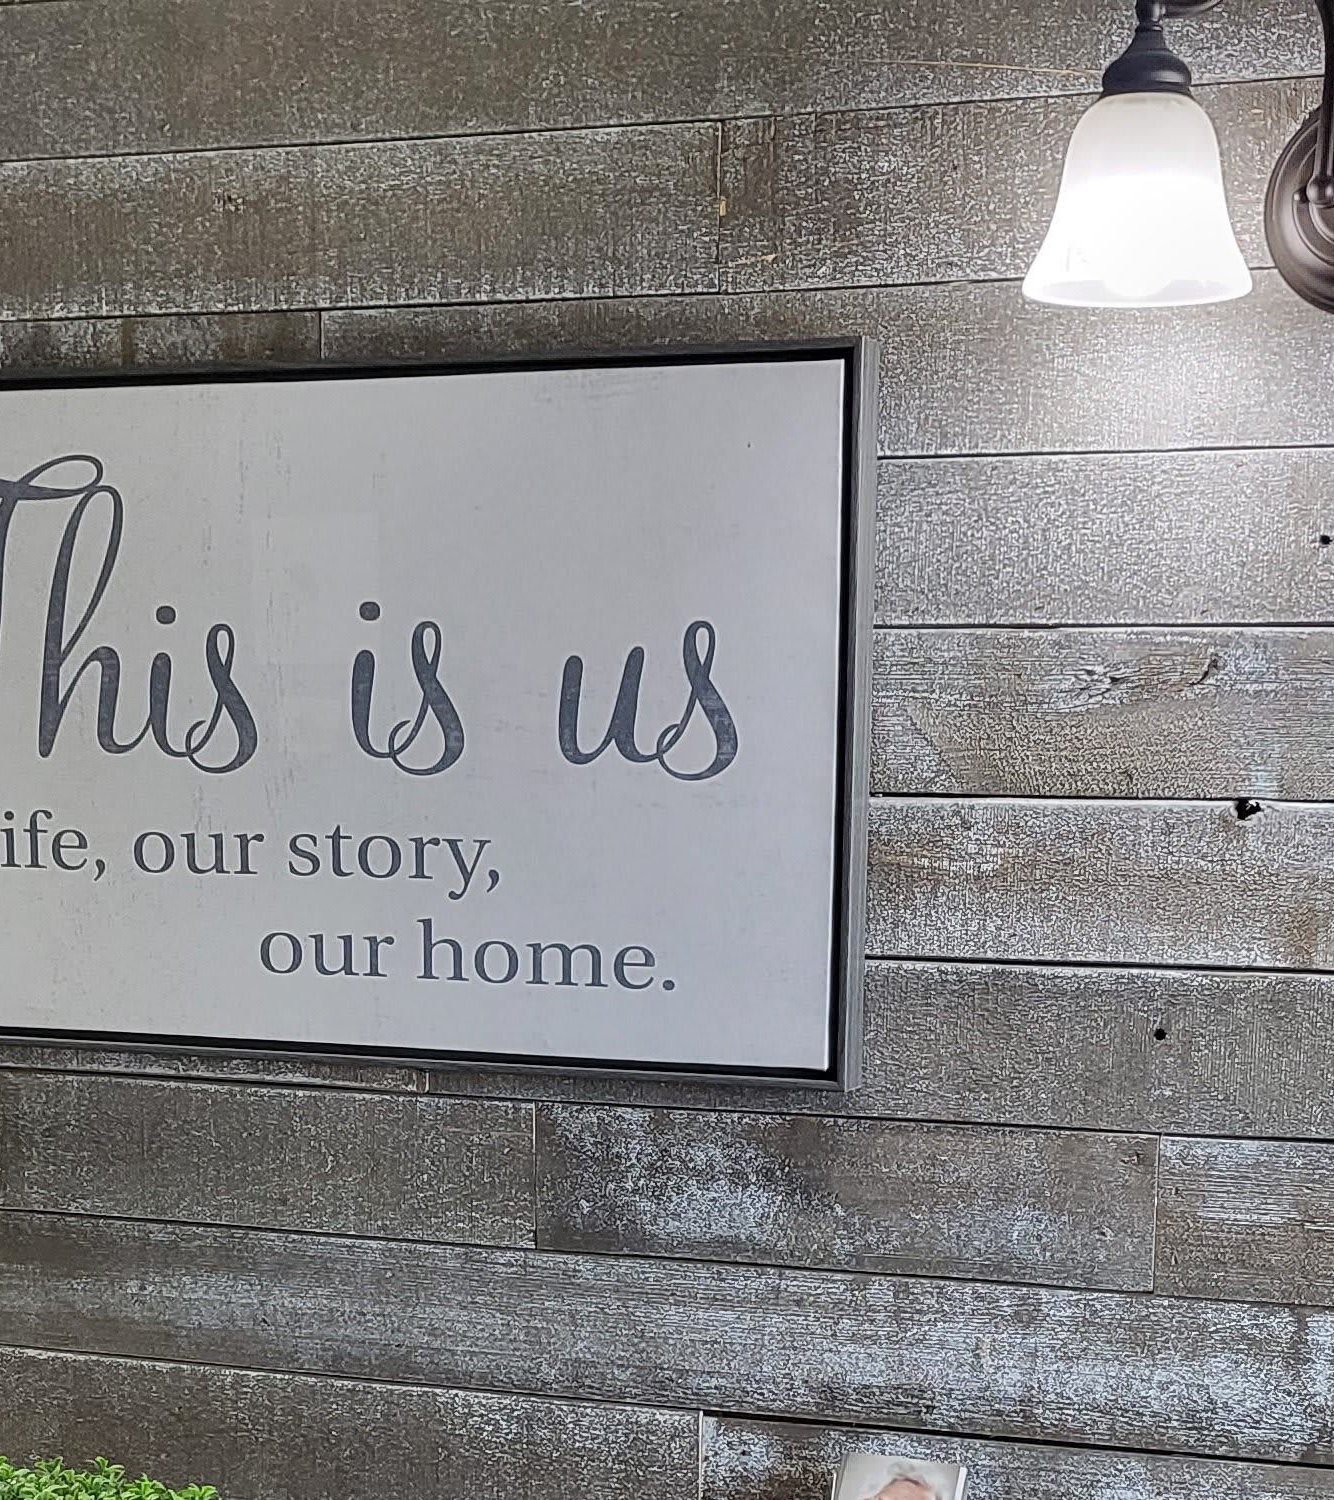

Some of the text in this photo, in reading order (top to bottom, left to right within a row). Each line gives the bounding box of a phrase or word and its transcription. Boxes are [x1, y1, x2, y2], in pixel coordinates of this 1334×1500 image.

[351, 601, 465, 777] is
[558, 620, 739, 782] us
[133, 831, 265, 875] our
[288, 824, 500, 901] story,
[260, 917, 676, 991] our home.
